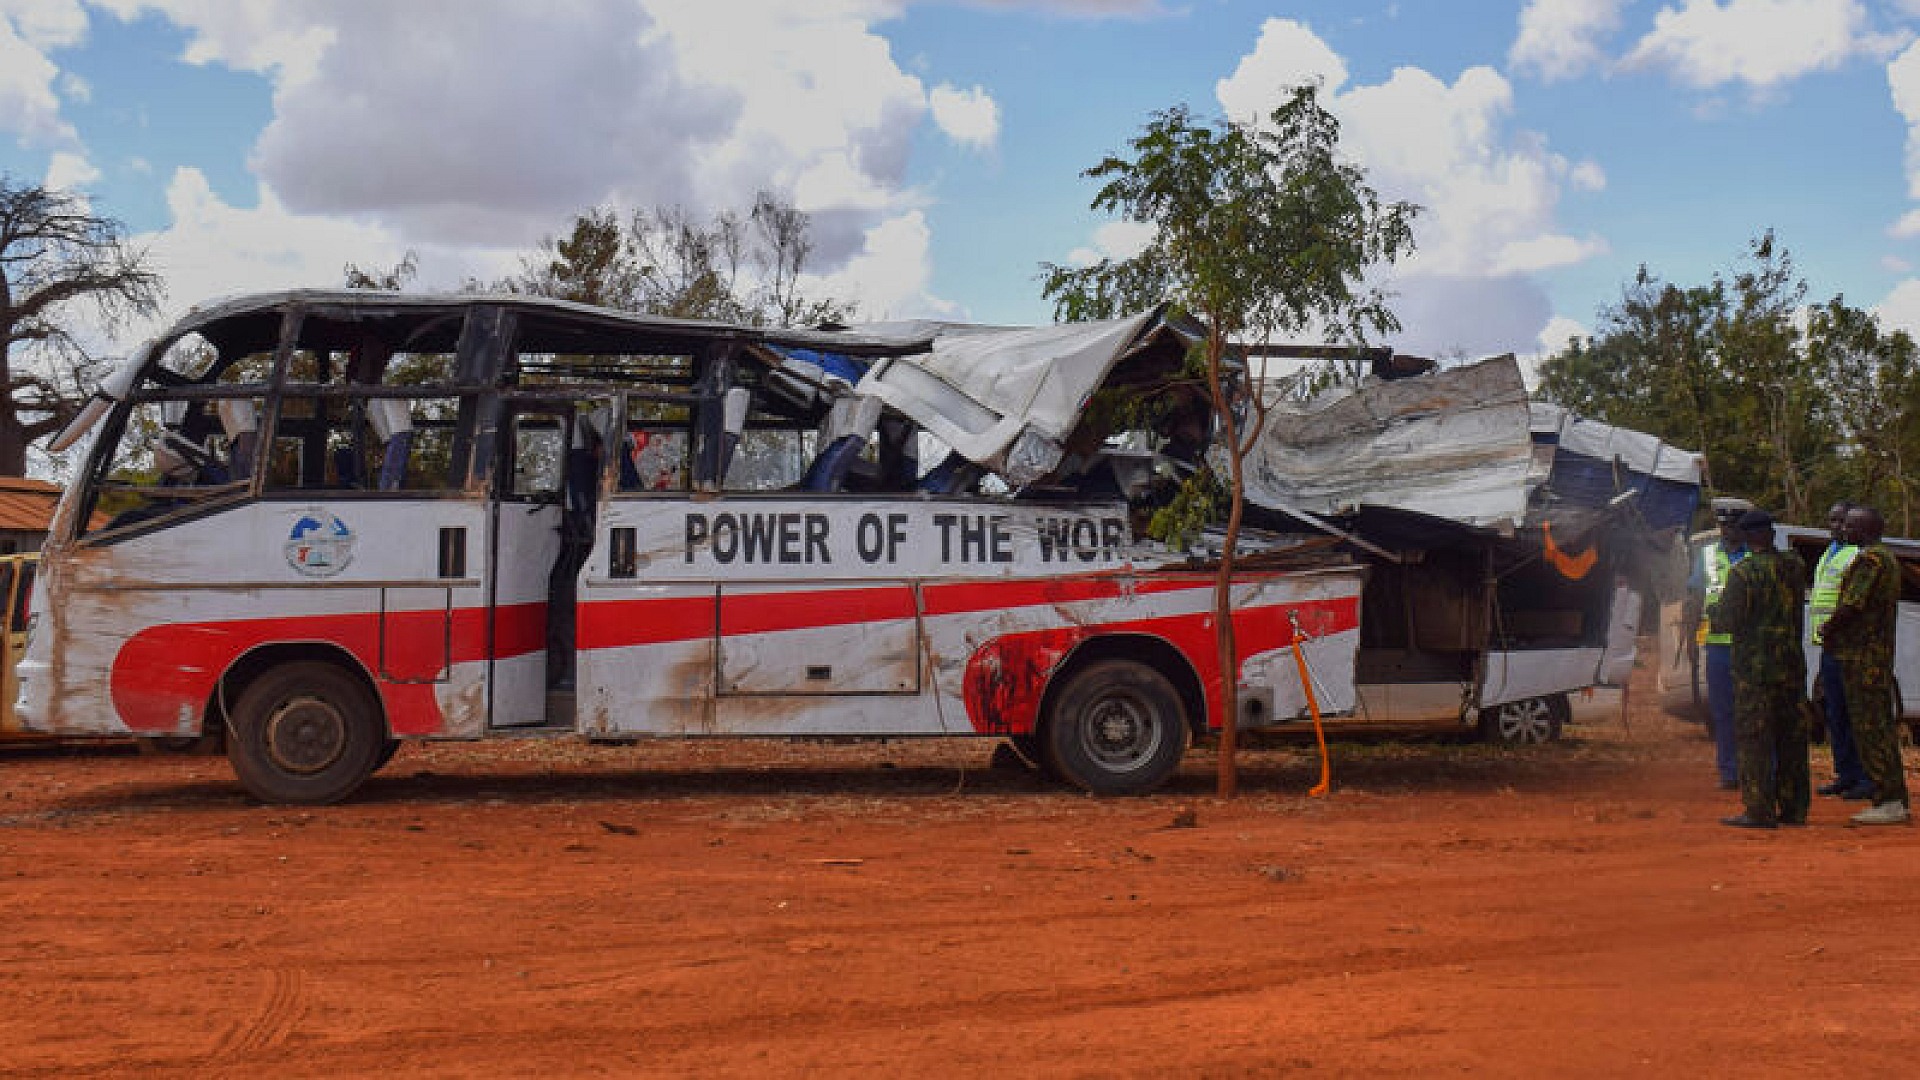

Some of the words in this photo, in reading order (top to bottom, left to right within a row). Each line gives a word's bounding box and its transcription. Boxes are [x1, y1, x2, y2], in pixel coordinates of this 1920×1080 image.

[685, 513, 832, 564] POWER
[857, 512, 908, 564] OF
[933, 514, 1013, 563] THE
[1036, 517, 1150, 562] WOR
